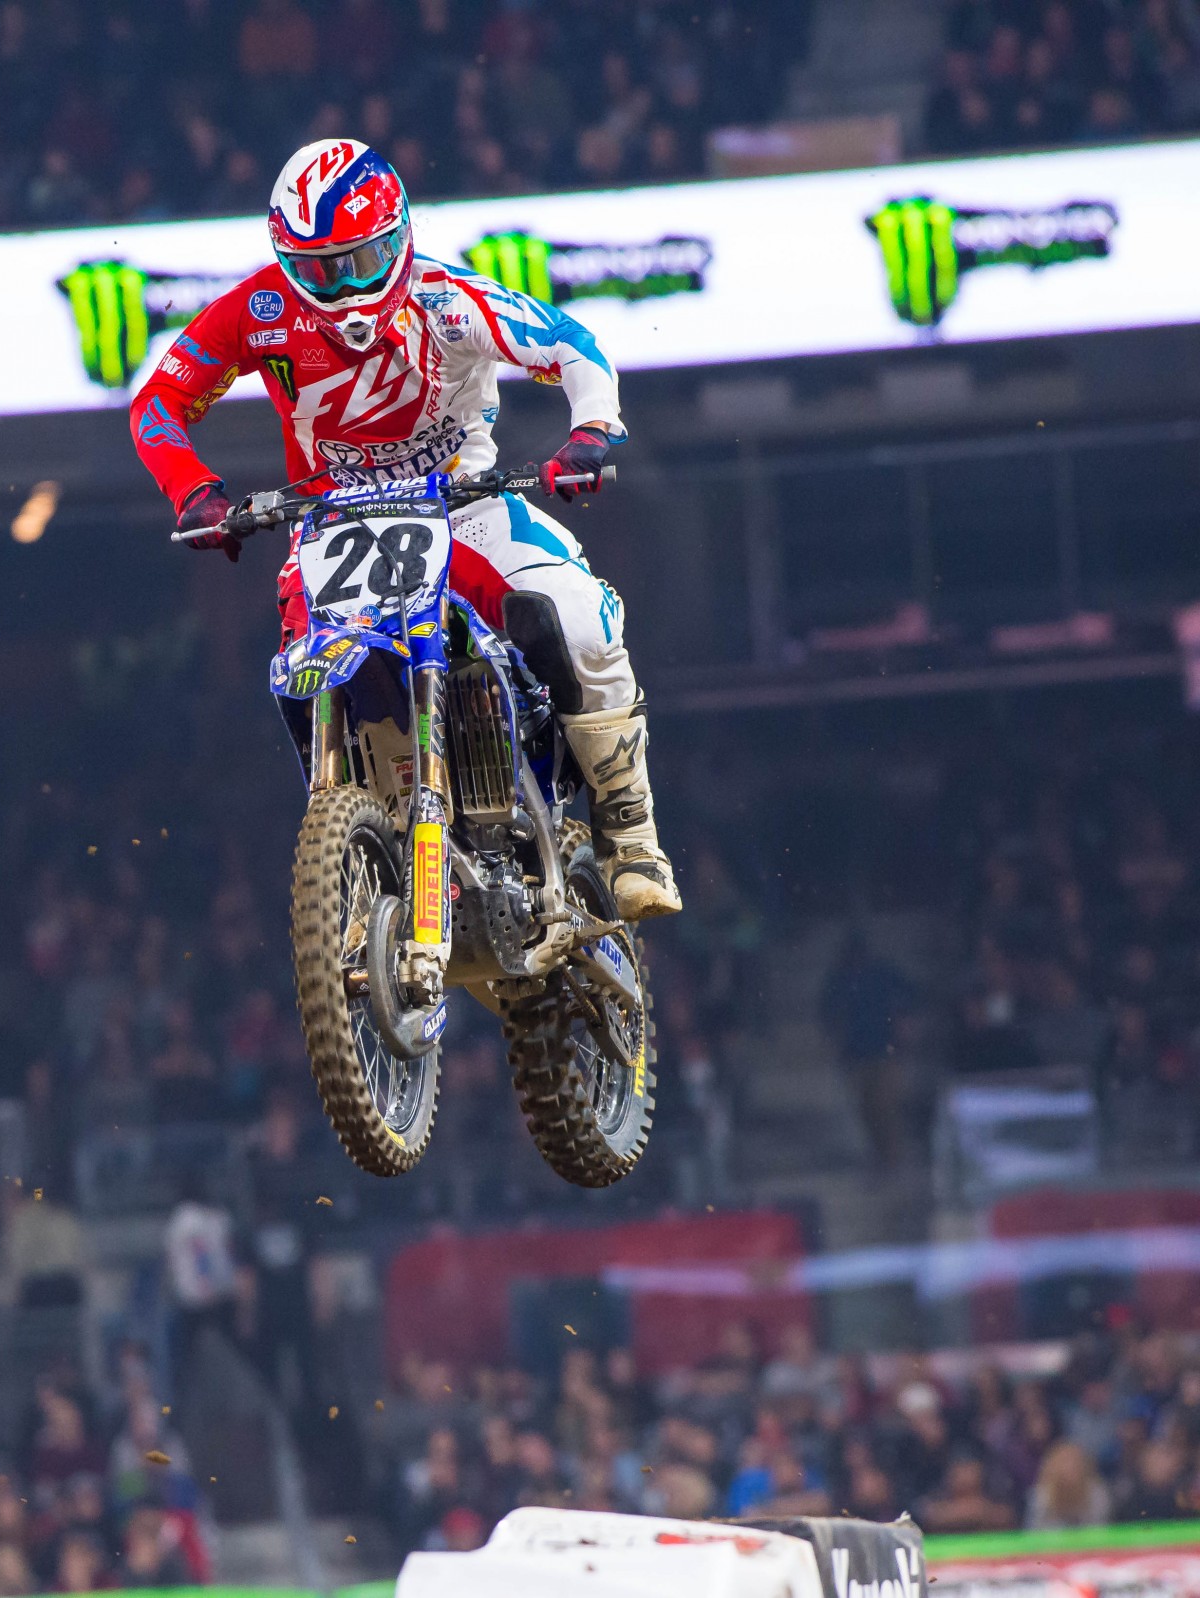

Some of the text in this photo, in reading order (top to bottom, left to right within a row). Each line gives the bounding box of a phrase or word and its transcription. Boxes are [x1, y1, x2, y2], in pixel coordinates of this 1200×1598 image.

[436, 314, 469, 326] AMA
[248, 328, 288, 348] WPS
[365, 414, 456, 457] TOYOTA
[505, 478, 535, 488] ARC
[315, 523, 433, 607] 28
[293, 659, 331, 673] YAMAHA
[417, 841, 439, 930] PIRELLI
